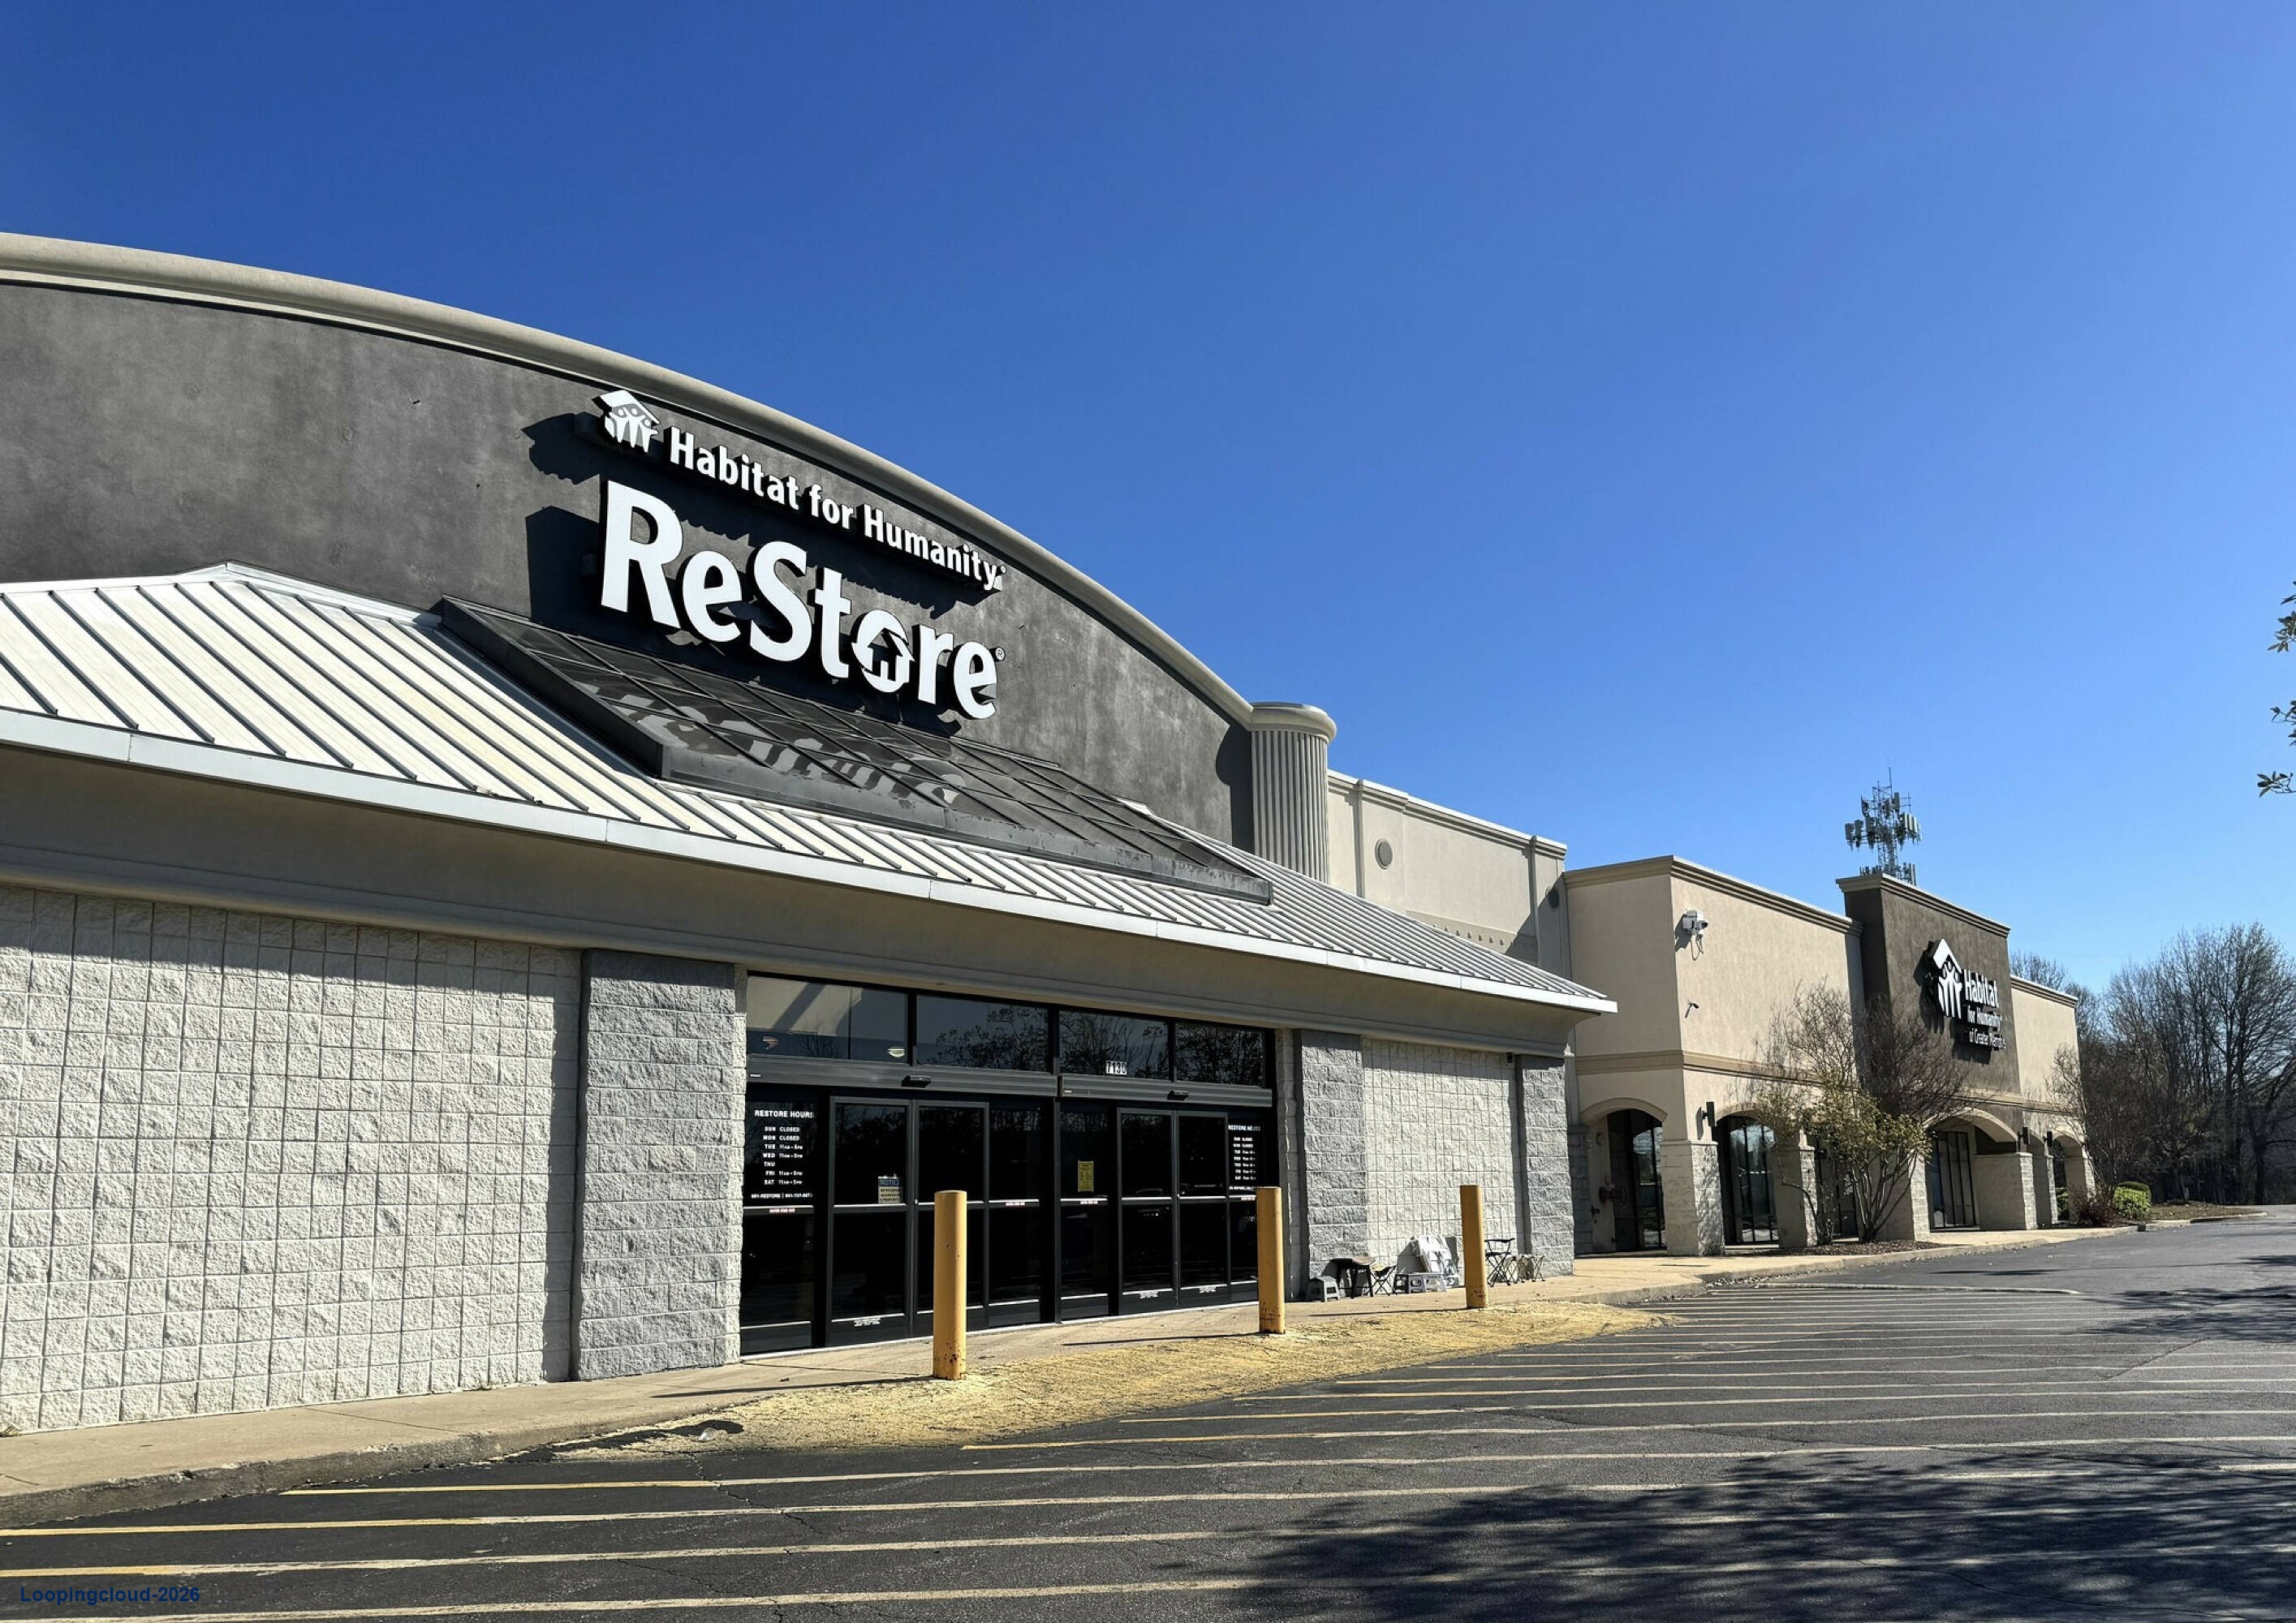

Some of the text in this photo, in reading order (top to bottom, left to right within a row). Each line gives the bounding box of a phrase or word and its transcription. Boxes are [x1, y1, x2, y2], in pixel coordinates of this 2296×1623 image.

[670, 426, 997, 591] Habitat for Humanity
[1964, 969, 1999, 1008] Habitat
[755, 1109, 814, 1118] RESTORE HOURS
